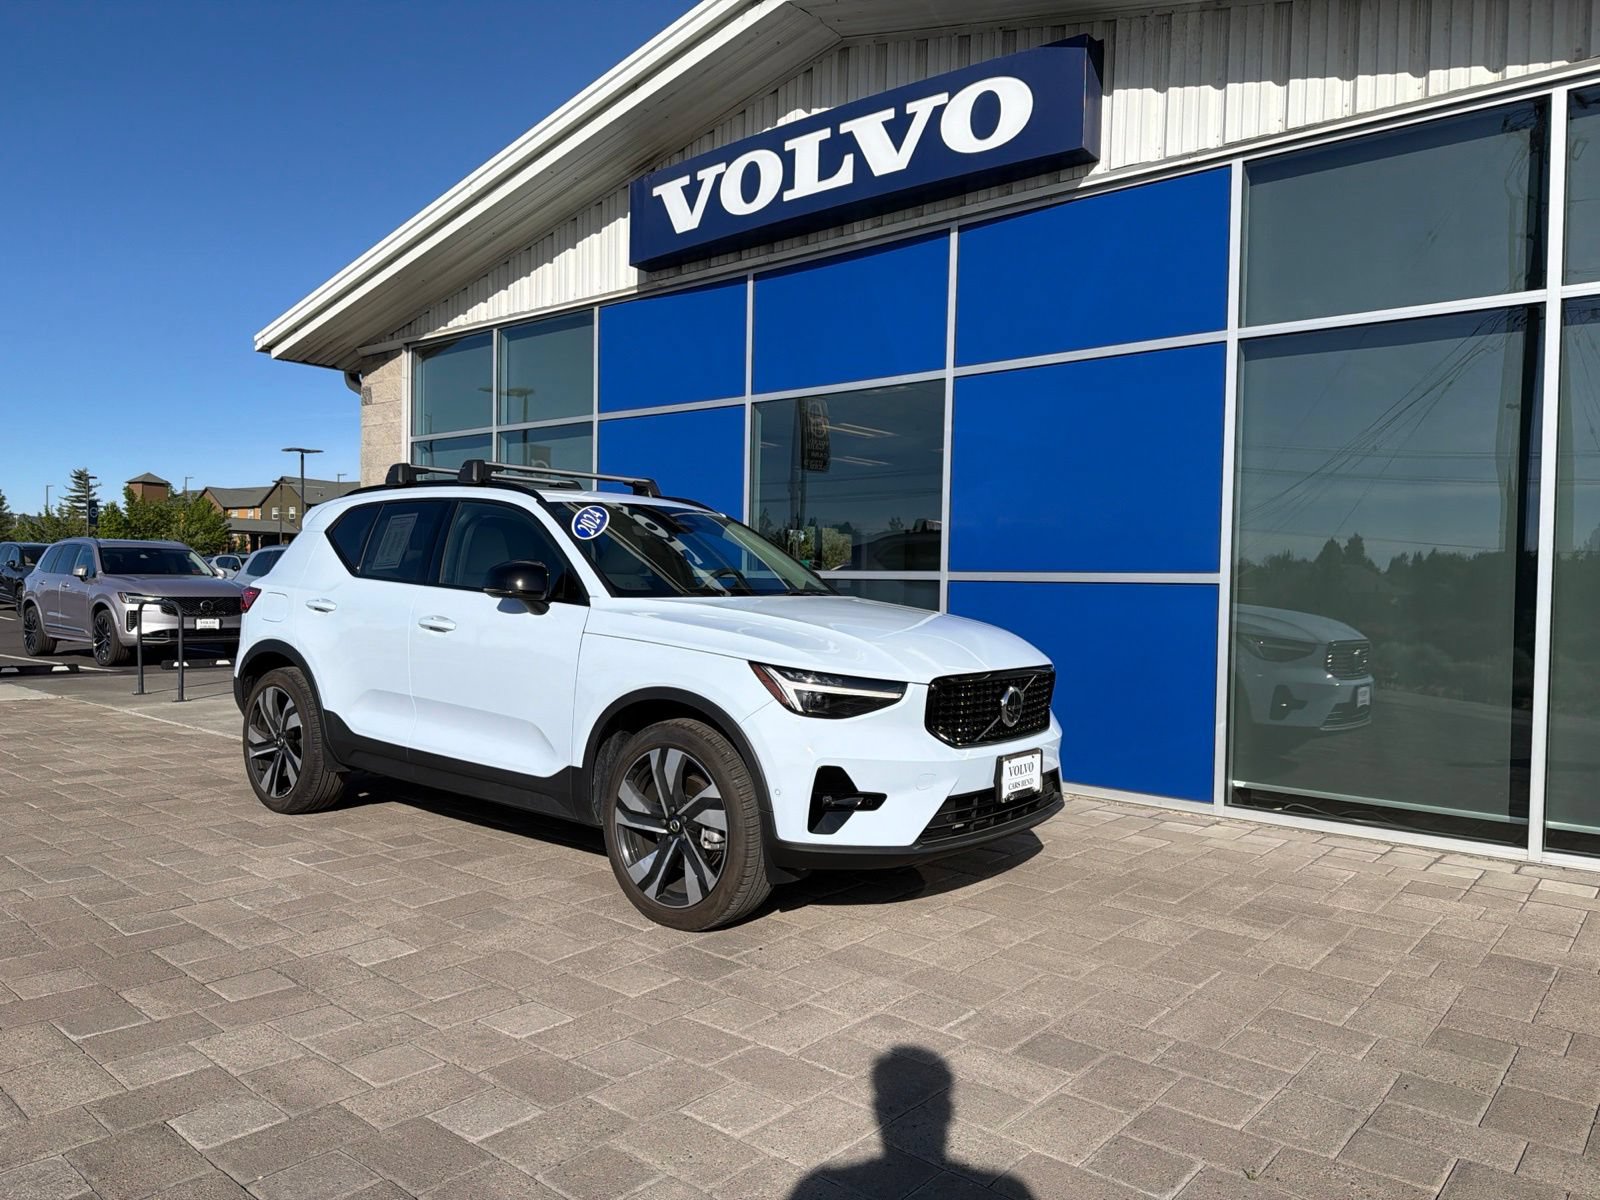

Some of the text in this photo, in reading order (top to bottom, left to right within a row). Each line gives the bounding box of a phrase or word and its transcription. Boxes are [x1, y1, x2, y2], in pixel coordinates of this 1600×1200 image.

[652, 76, 1034, 234] VOLVO
[577, 508, 603, 536] 2024
[1009, 762, 1034, 777] VOLVO
[1008, 781, 1020, 790] CARS
